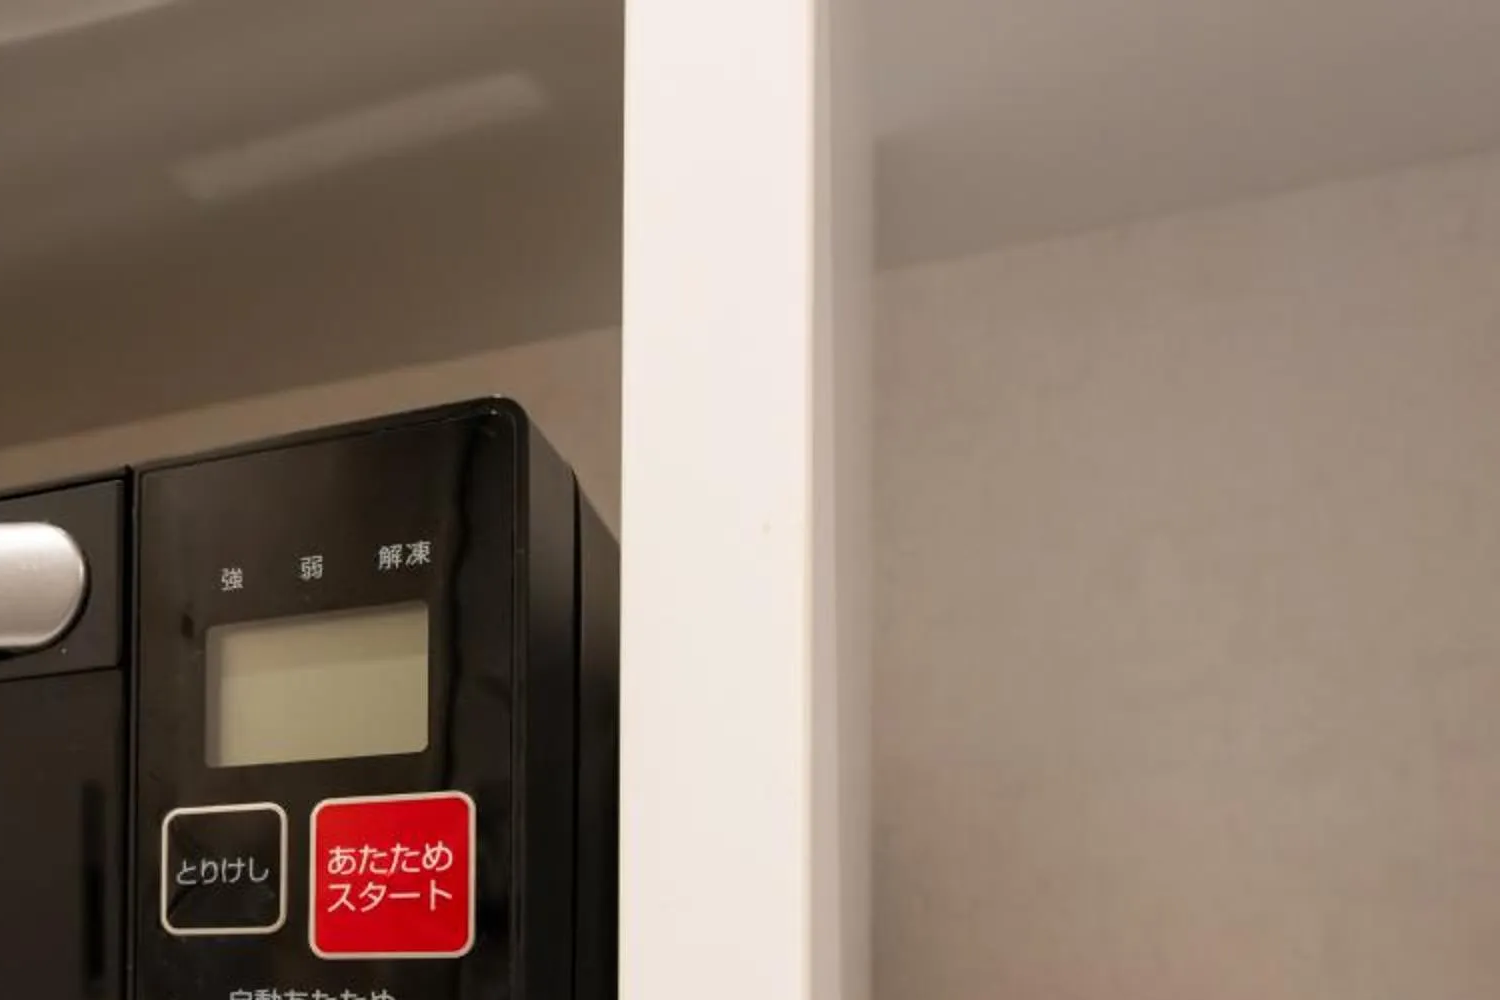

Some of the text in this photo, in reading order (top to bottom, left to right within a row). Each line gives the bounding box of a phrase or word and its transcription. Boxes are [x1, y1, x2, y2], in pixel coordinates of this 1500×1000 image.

[221, 540, 432, 592] 強 弱 解凍
[175, 856, 269, 885] とりけし
[327, 840, 454, 878] あたため
[327, 879, 453, 913] スタート
